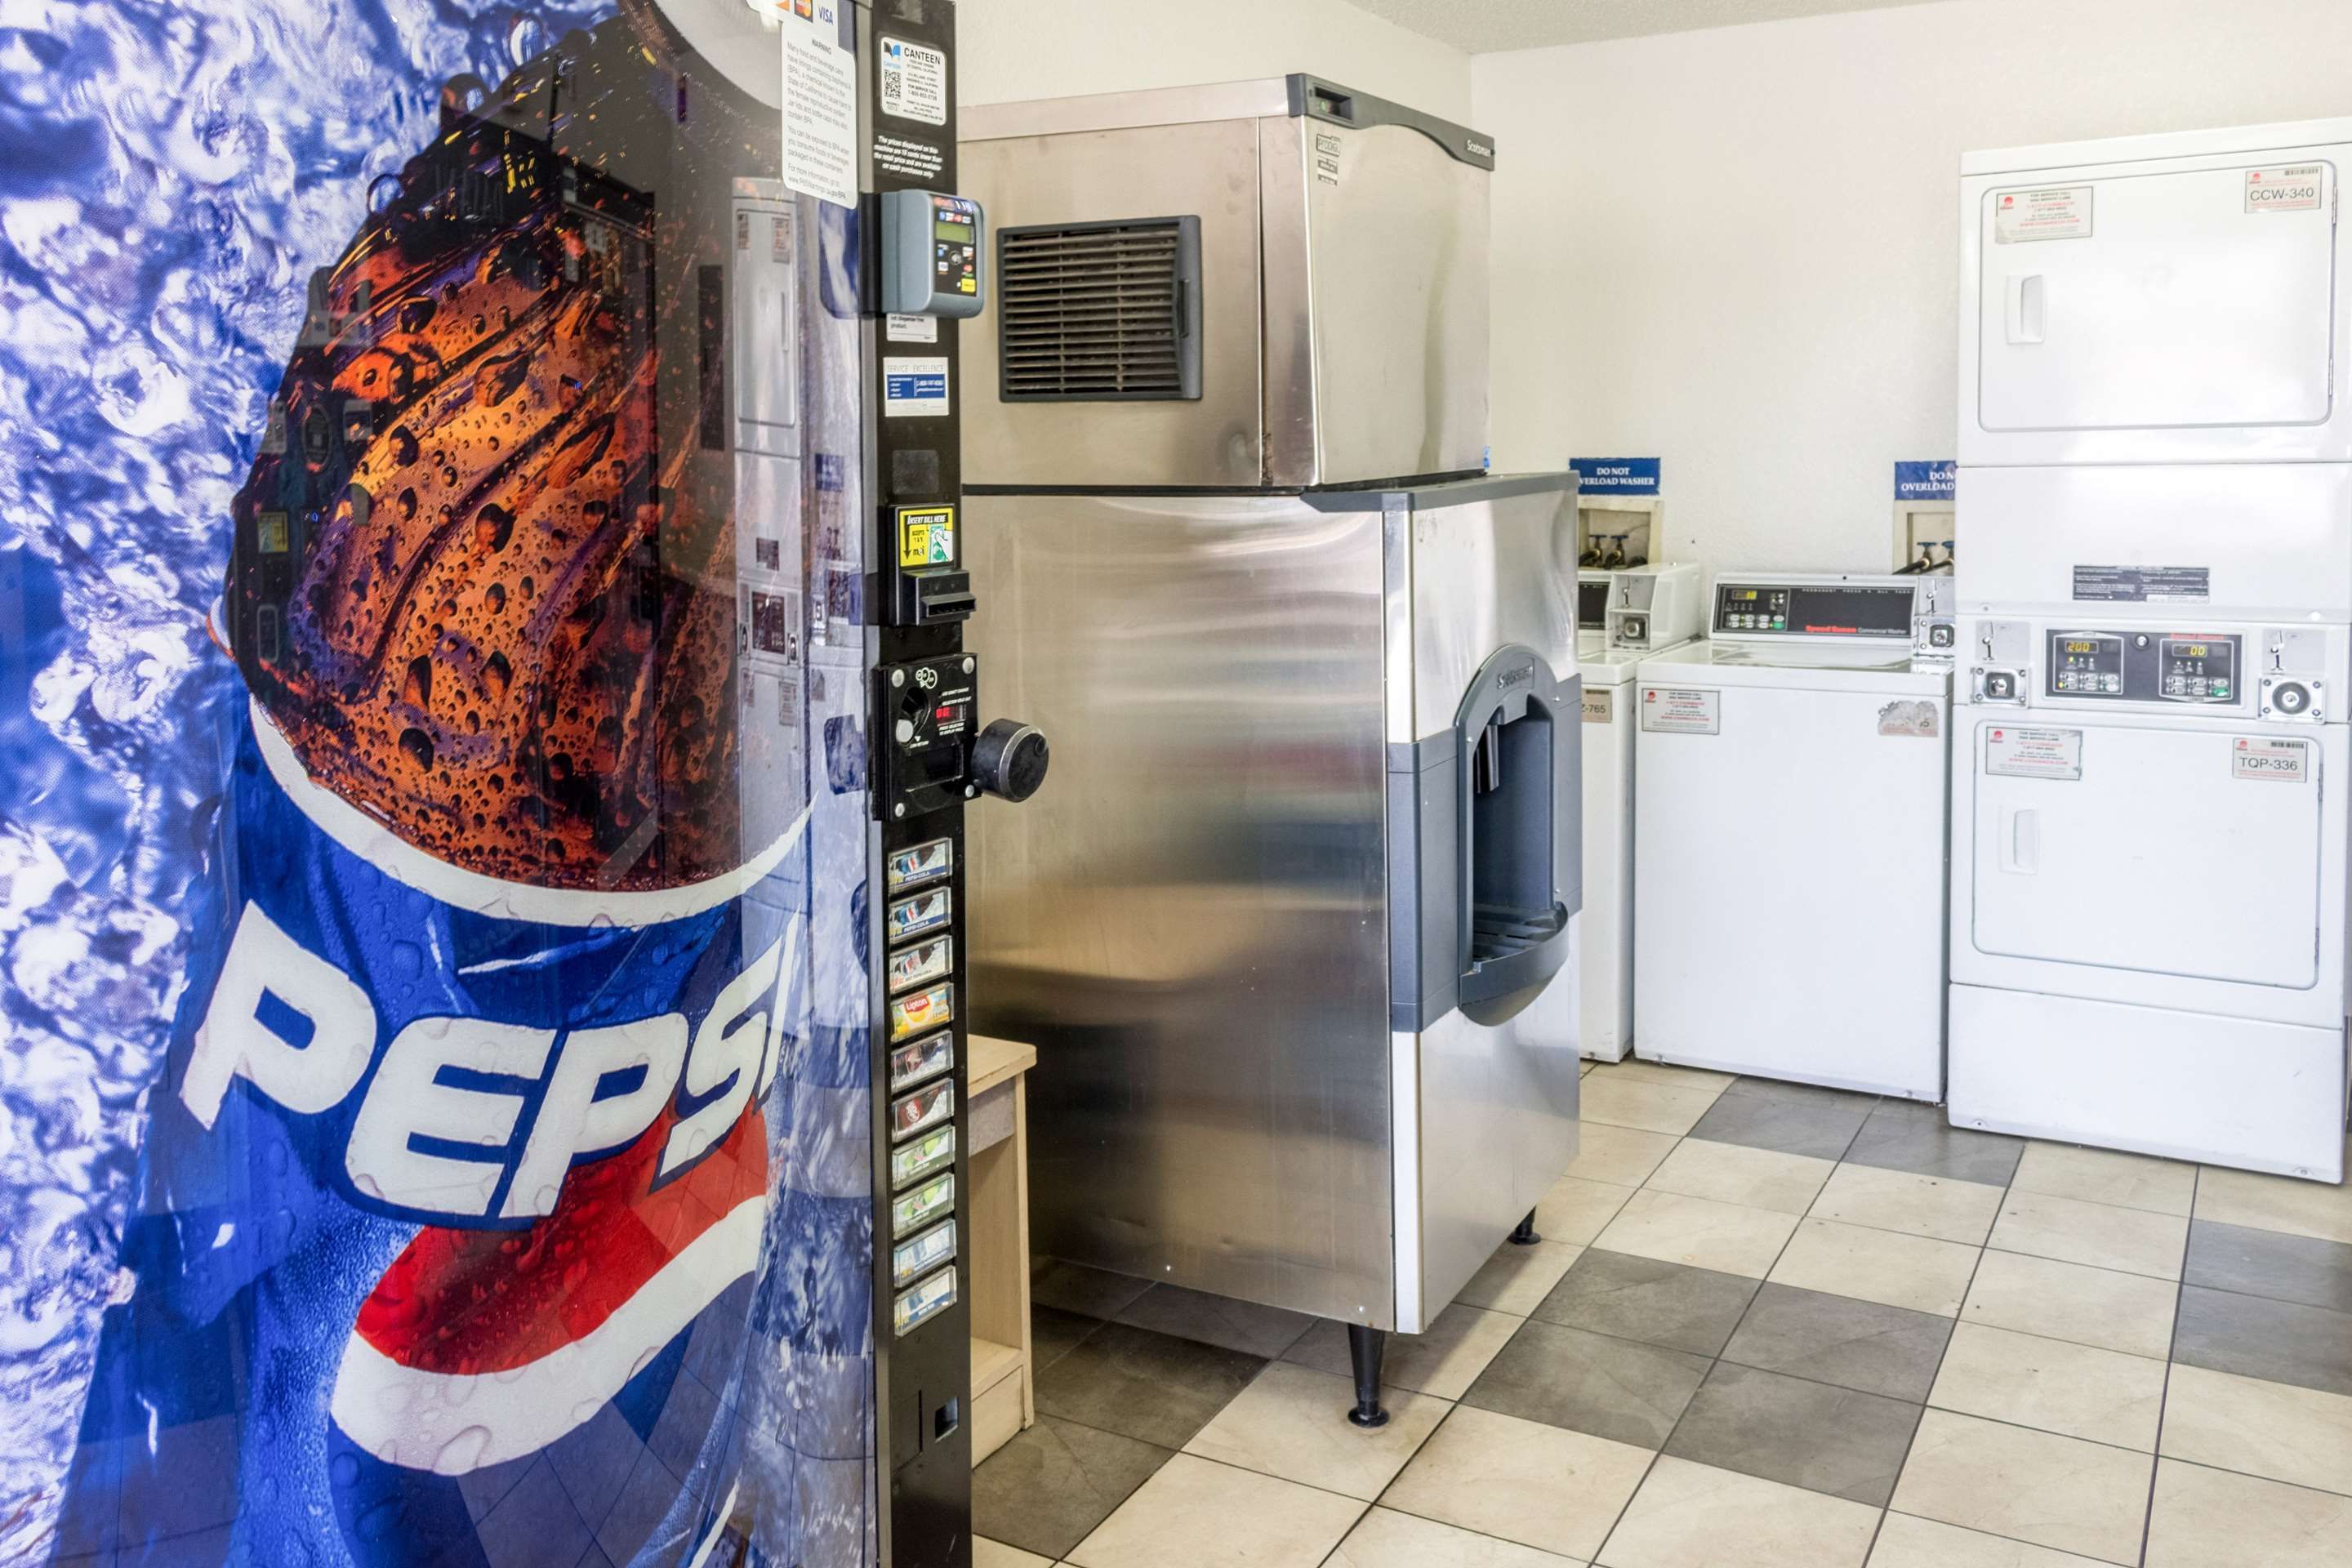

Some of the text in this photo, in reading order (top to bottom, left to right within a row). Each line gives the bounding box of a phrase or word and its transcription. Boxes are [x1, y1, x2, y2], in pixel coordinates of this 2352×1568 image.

[819, 6, 834, 25] VISA
[904, 47, 940, 65] CANTEEN
[2250, 187, 2314, 201] CCW-340
[1597, 467, 1630, 475] DO NOT
[1929, 471, 1945, 480] DO
[1579, 477, 1655, 486] VERLOAD WASHER
[1901, 483, 1955, 492] OVERLOAD
[2239, 757, 2298, 771] TQP-336
[905, 997, 929, 1012] Lipton
[179, 898, 801, 1218] PEPSI
